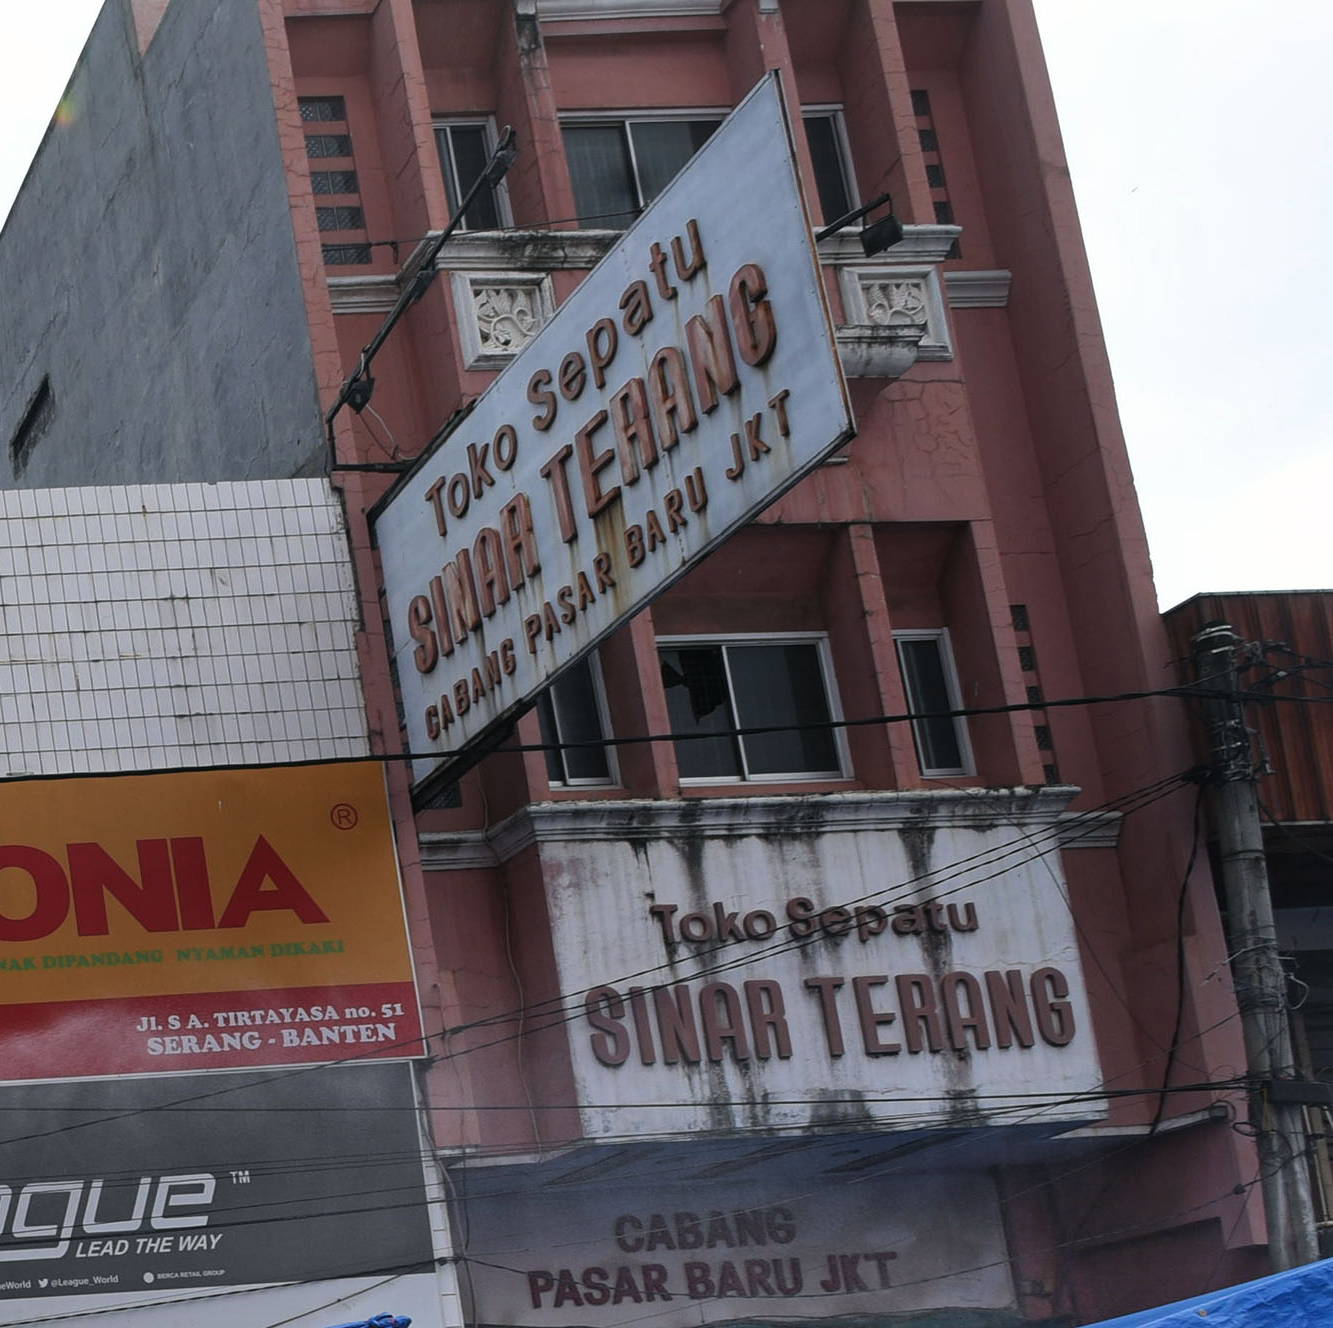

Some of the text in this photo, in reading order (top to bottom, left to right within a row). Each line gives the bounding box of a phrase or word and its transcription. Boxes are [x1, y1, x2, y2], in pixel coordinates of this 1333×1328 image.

[407, 263, 778, 675] SINAR TERANG
[424, 388, 791, 740] CABANG PASAR BARU JKT
[650, 896, 980, 944] Toko Sepatu
[42, 949, 164, 971] DIPANDANG
[176, 945, 266, 963] NYAMAN
[270, 939, 345, 956] DIKAKI
[146, 1031, 262, 1056] SERANG
[281, 1022, 397, 1048] BANTEN
[213, 1005, 337, 1028] TIRTAYASA
[343, 1005, 376, 1019] no.
[381, 1003, 405, 1018] 51
[585, 966, 1077, 1067] SINAR TERANG
[75, 1233, 224, 1258] LEAD THE WAY
[613, 1206, 797, 1254] CABANG
[50, 1273, 120, 1289] @League_World
[527, 1251, 898, 1309] PASAR BARU JKT
